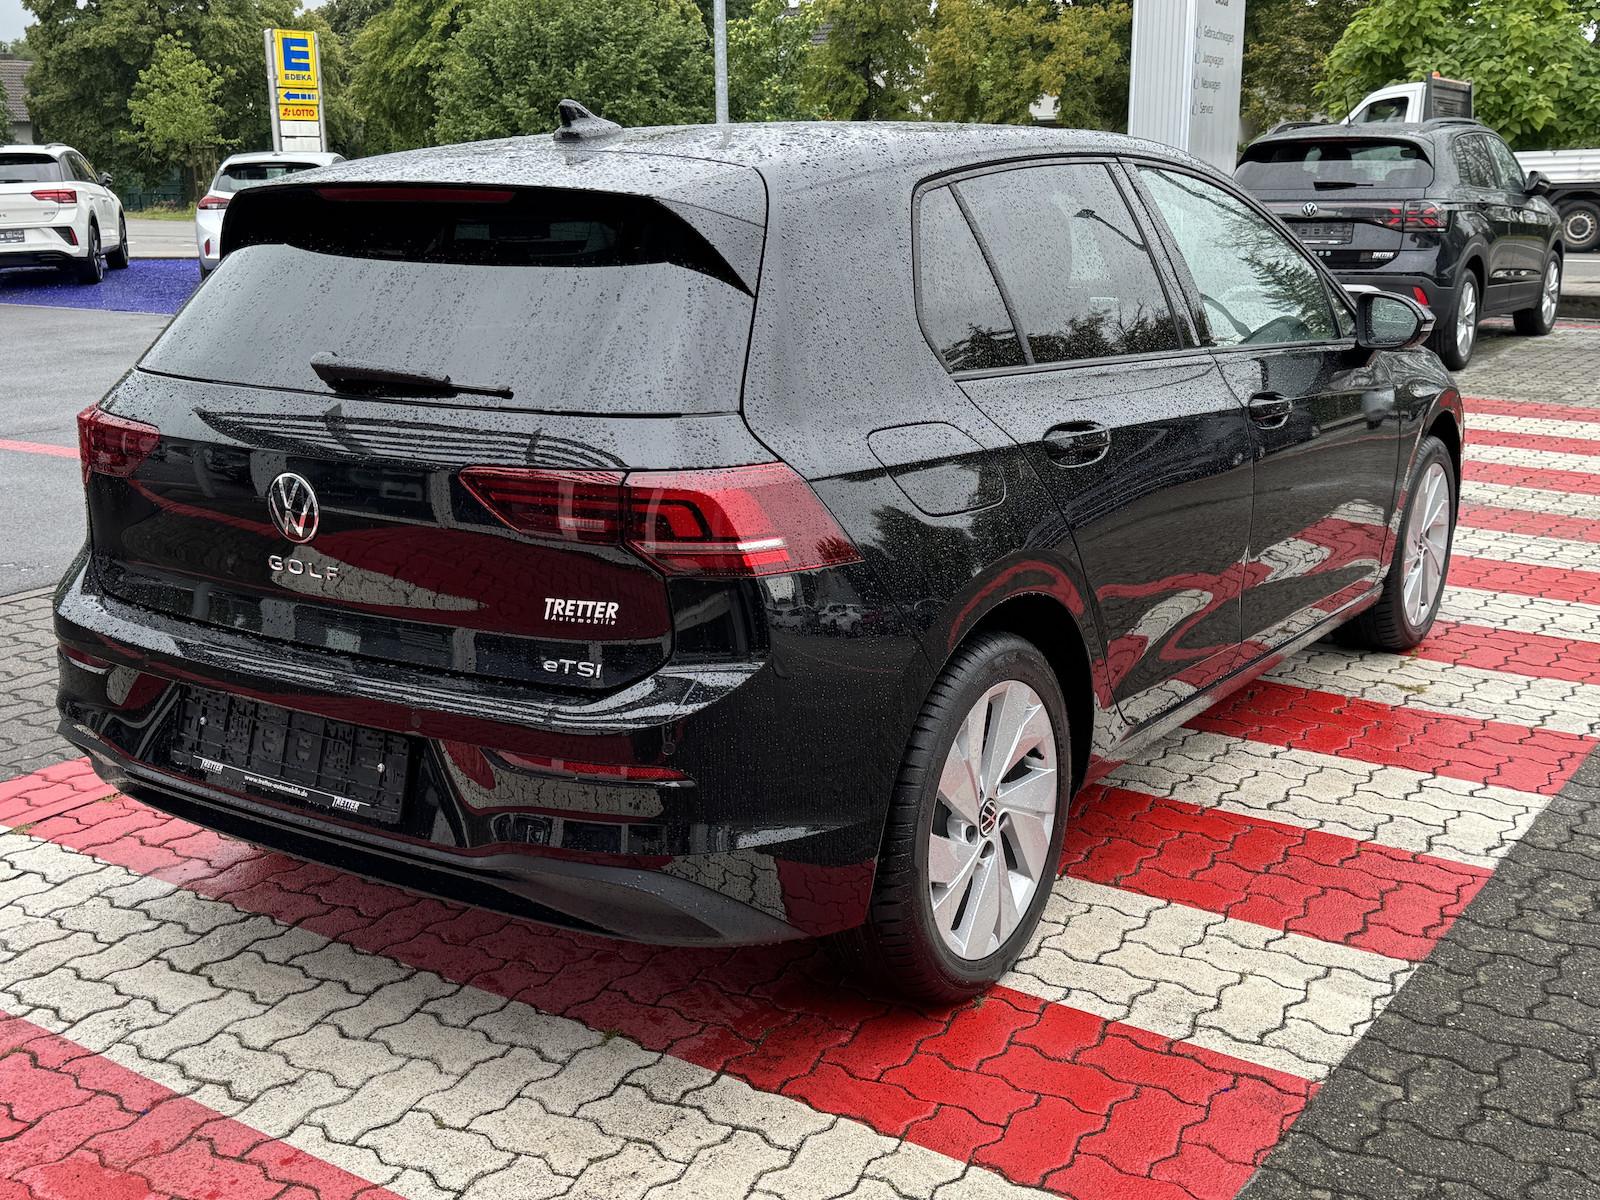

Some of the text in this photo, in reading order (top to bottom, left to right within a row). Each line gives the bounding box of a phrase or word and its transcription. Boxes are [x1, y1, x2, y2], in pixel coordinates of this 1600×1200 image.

[285, 73, 312, 81] EDEKA
[292, 109, 315, 117] LOTTO
[1200, 102, 1214, 114] Service
[268, 555, 338, 580] GOLF
[544, 598, 619, 620] TRETTER
[551, 614, 616, 625] Automobile
[543, 659, 602, 679] eTSI
[200, 759, 224, 774] TRETTER
[244, 775, 308, 798] www.tretter-automobile.de
[332, 796, 360, 811] TRETTER
